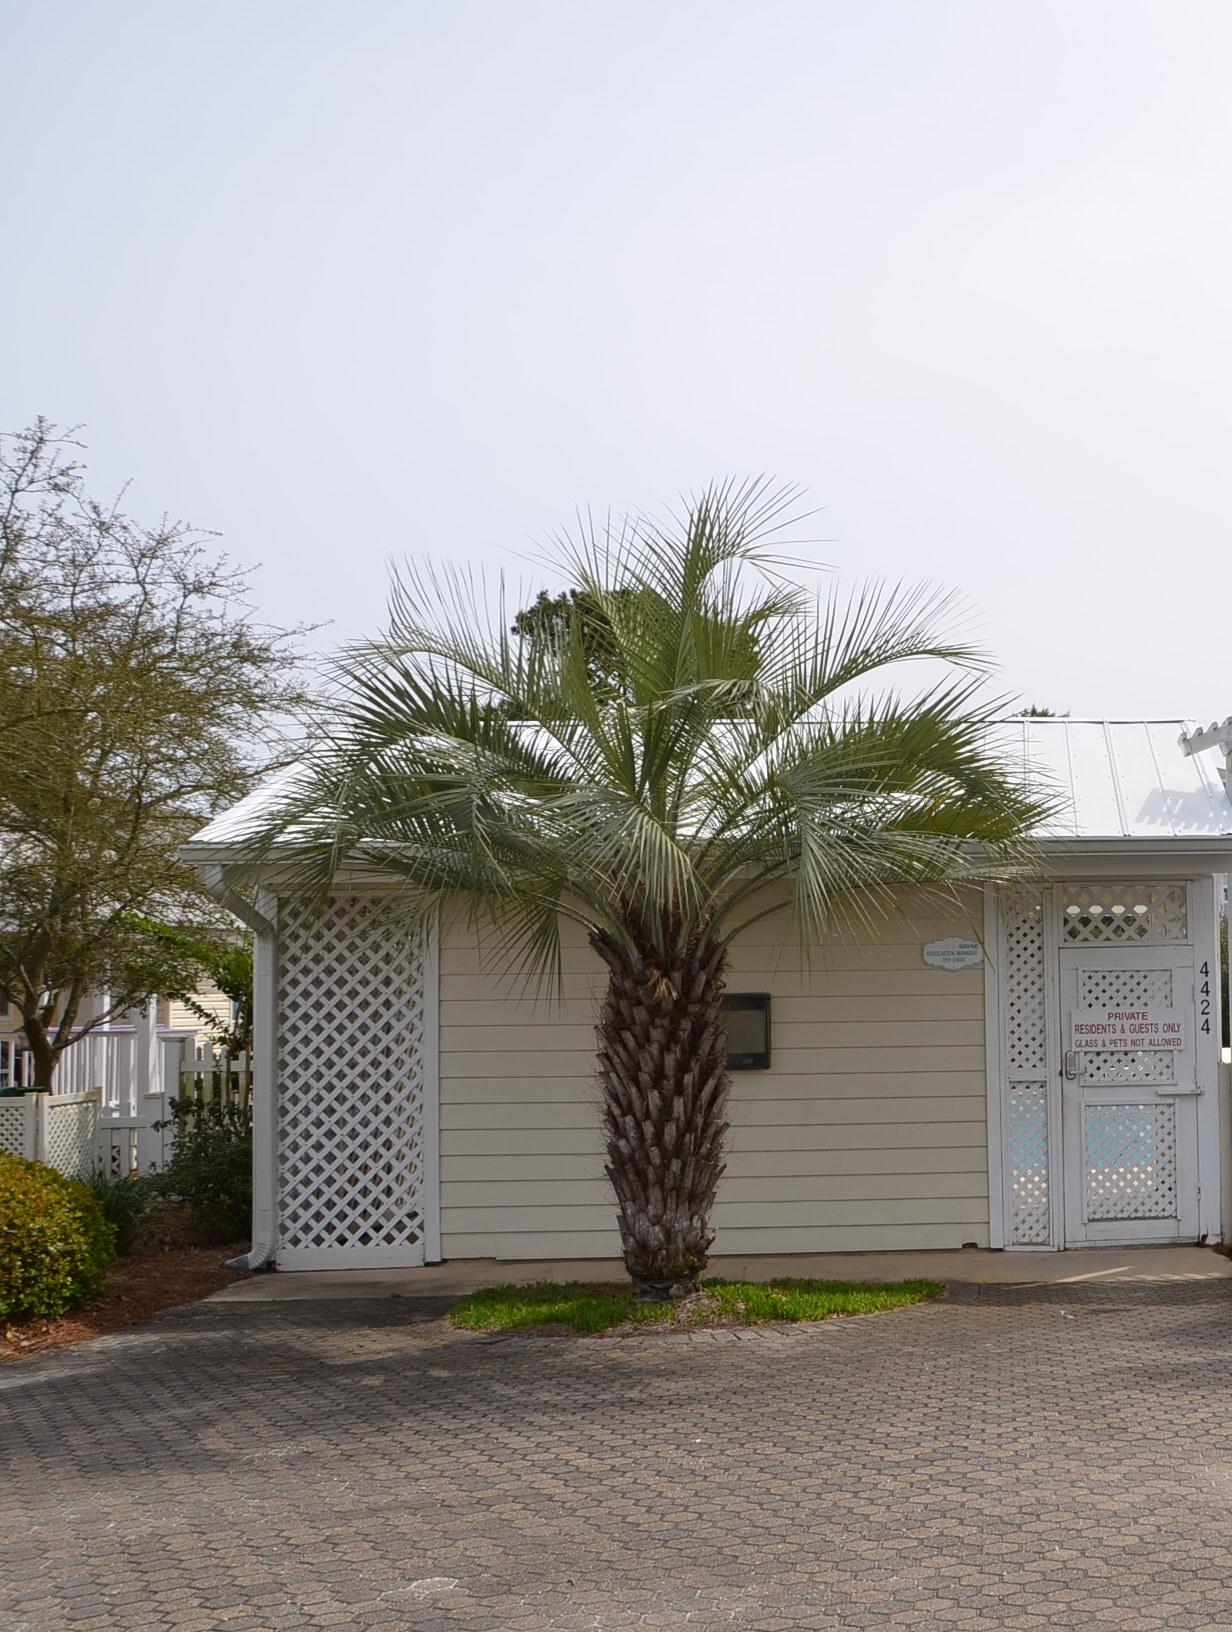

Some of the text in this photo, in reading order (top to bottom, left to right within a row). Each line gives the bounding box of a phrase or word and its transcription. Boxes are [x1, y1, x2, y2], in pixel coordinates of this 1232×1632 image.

[1107, 1011, 1149, 1021] PRIVATE
[1074, 1023, 1182, 1035] RESIDENTS & GUESTS ONLY
[1074, 1037, 1182, 1048] GLASS & PETS NOT ALLOWED
